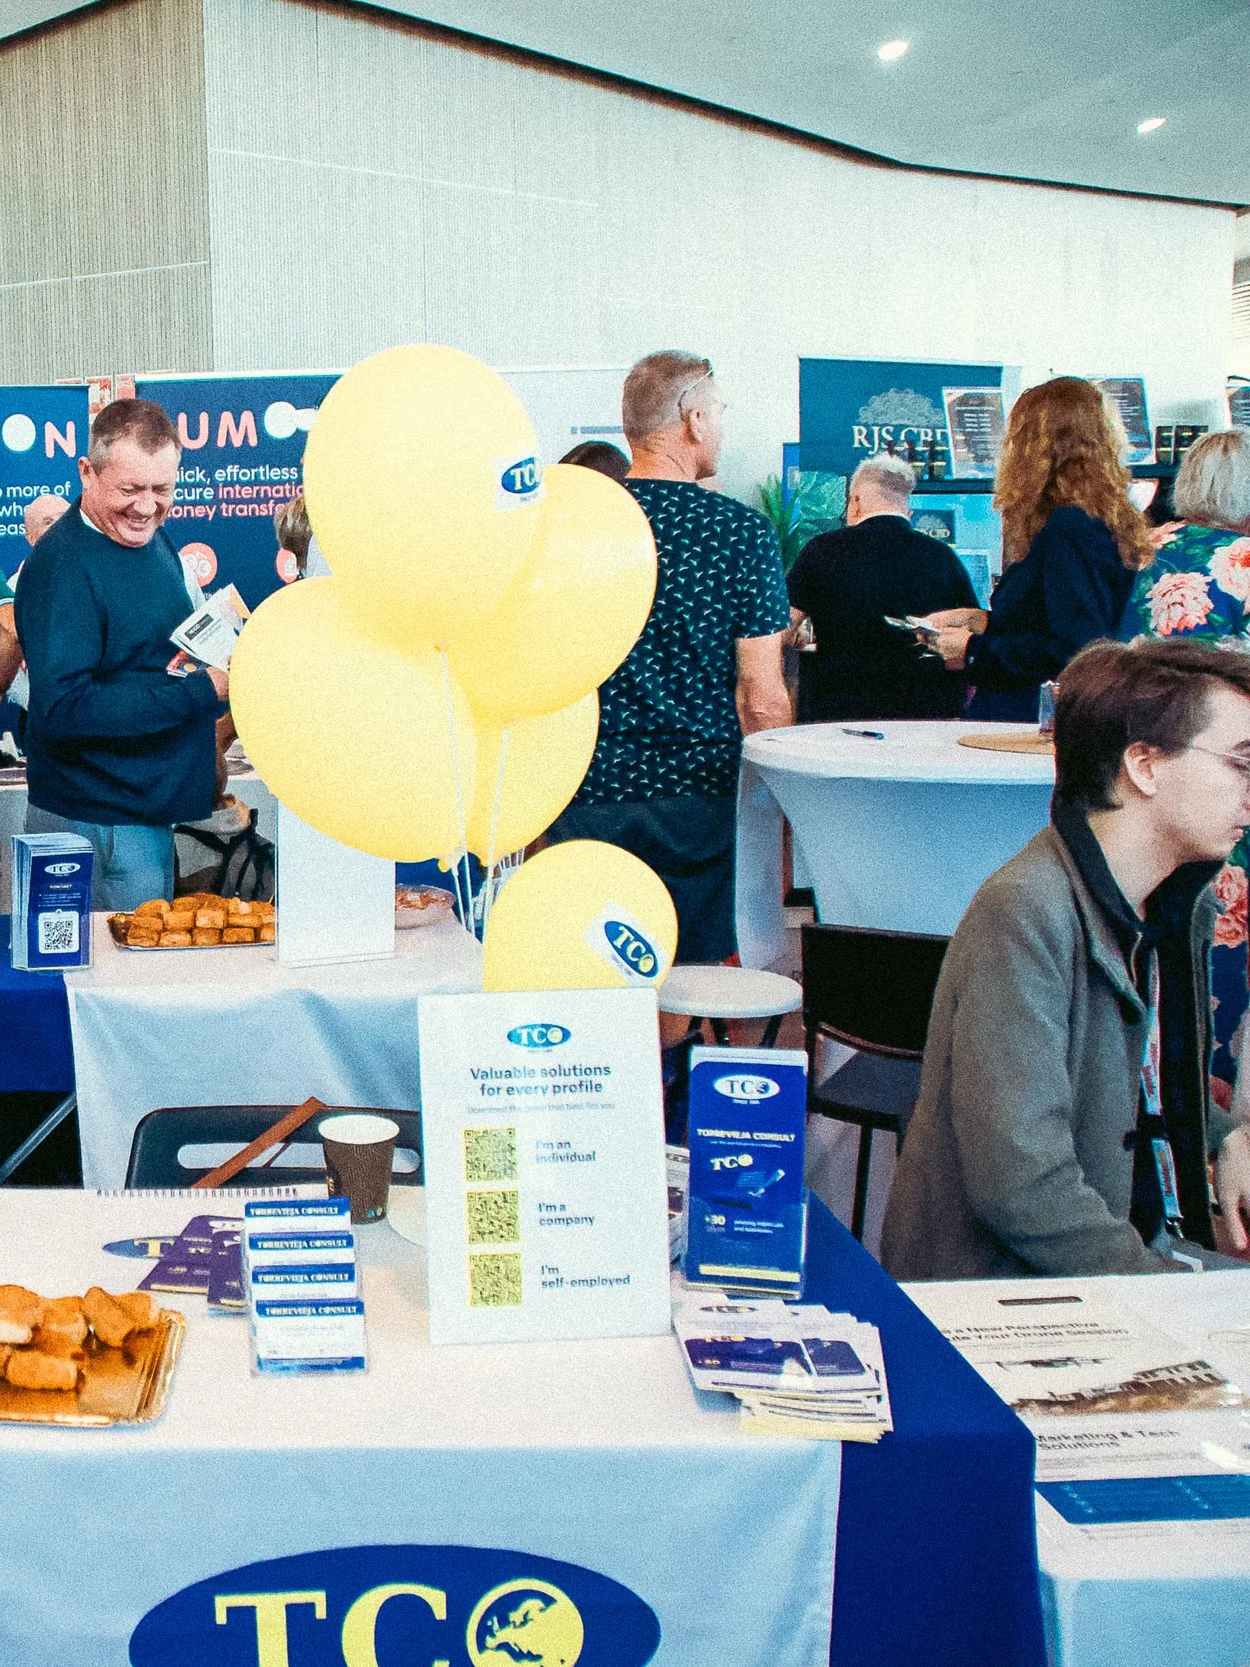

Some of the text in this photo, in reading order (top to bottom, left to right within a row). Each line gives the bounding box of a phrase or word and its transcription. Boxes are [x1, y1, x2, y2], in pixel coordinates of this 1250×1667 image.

[214, 464, 299, 482] effortless
[6, 484, 51, 499] more
[54, 480, 71, 496] of
[470, 1064, 611, 1080] Valuable solutions
[480, 1080, 603, 1097] for every profile
[556, 1141, 572, 1149] an
[535, 1151, 596, 1163] individual
[559, 1204, 567, 1212] a
[539, 1216, 595, 1226] company
[541, 1275, 631, 1289] self-employed
[1037, 1441, 1121, 1451] Solutions
